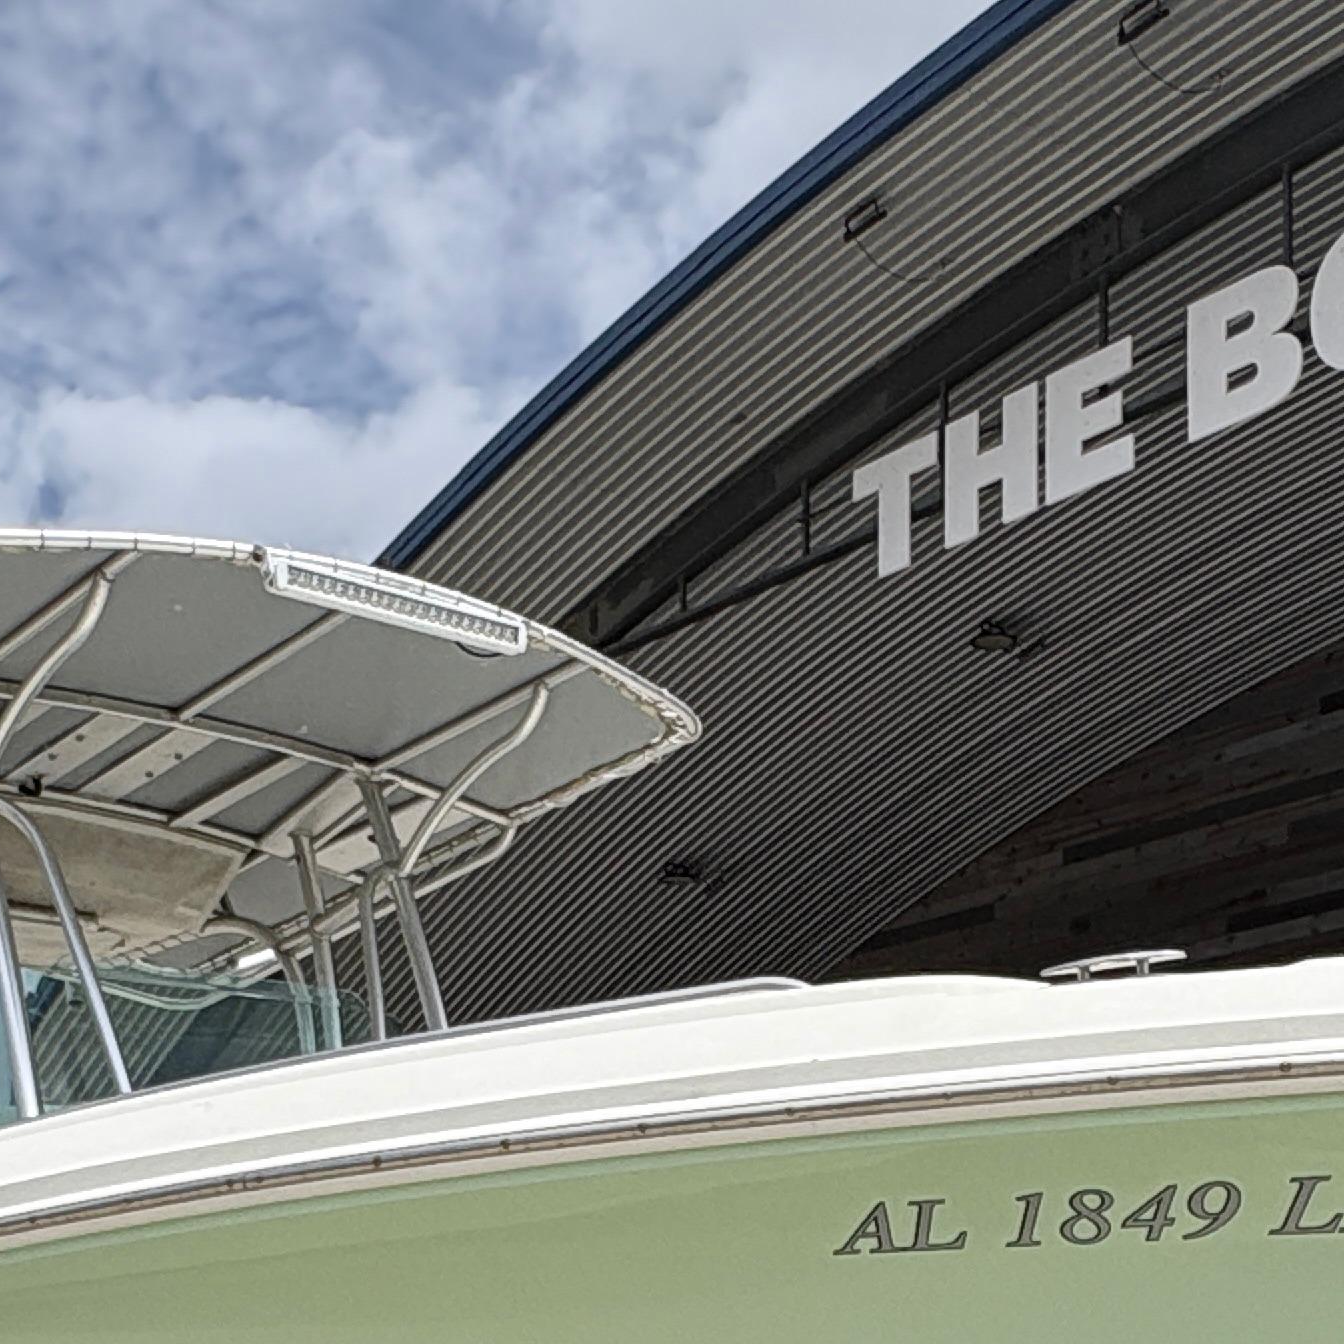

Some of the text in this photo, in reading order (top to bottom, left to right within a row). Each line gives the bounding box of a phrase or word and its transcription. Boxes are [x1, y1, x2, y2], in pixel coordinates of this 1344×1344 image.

[853, 335, 1135, 577] THE
[832, 1198, 968, 1256] AL
[1004, 1179, 1242, 1249] 1849
